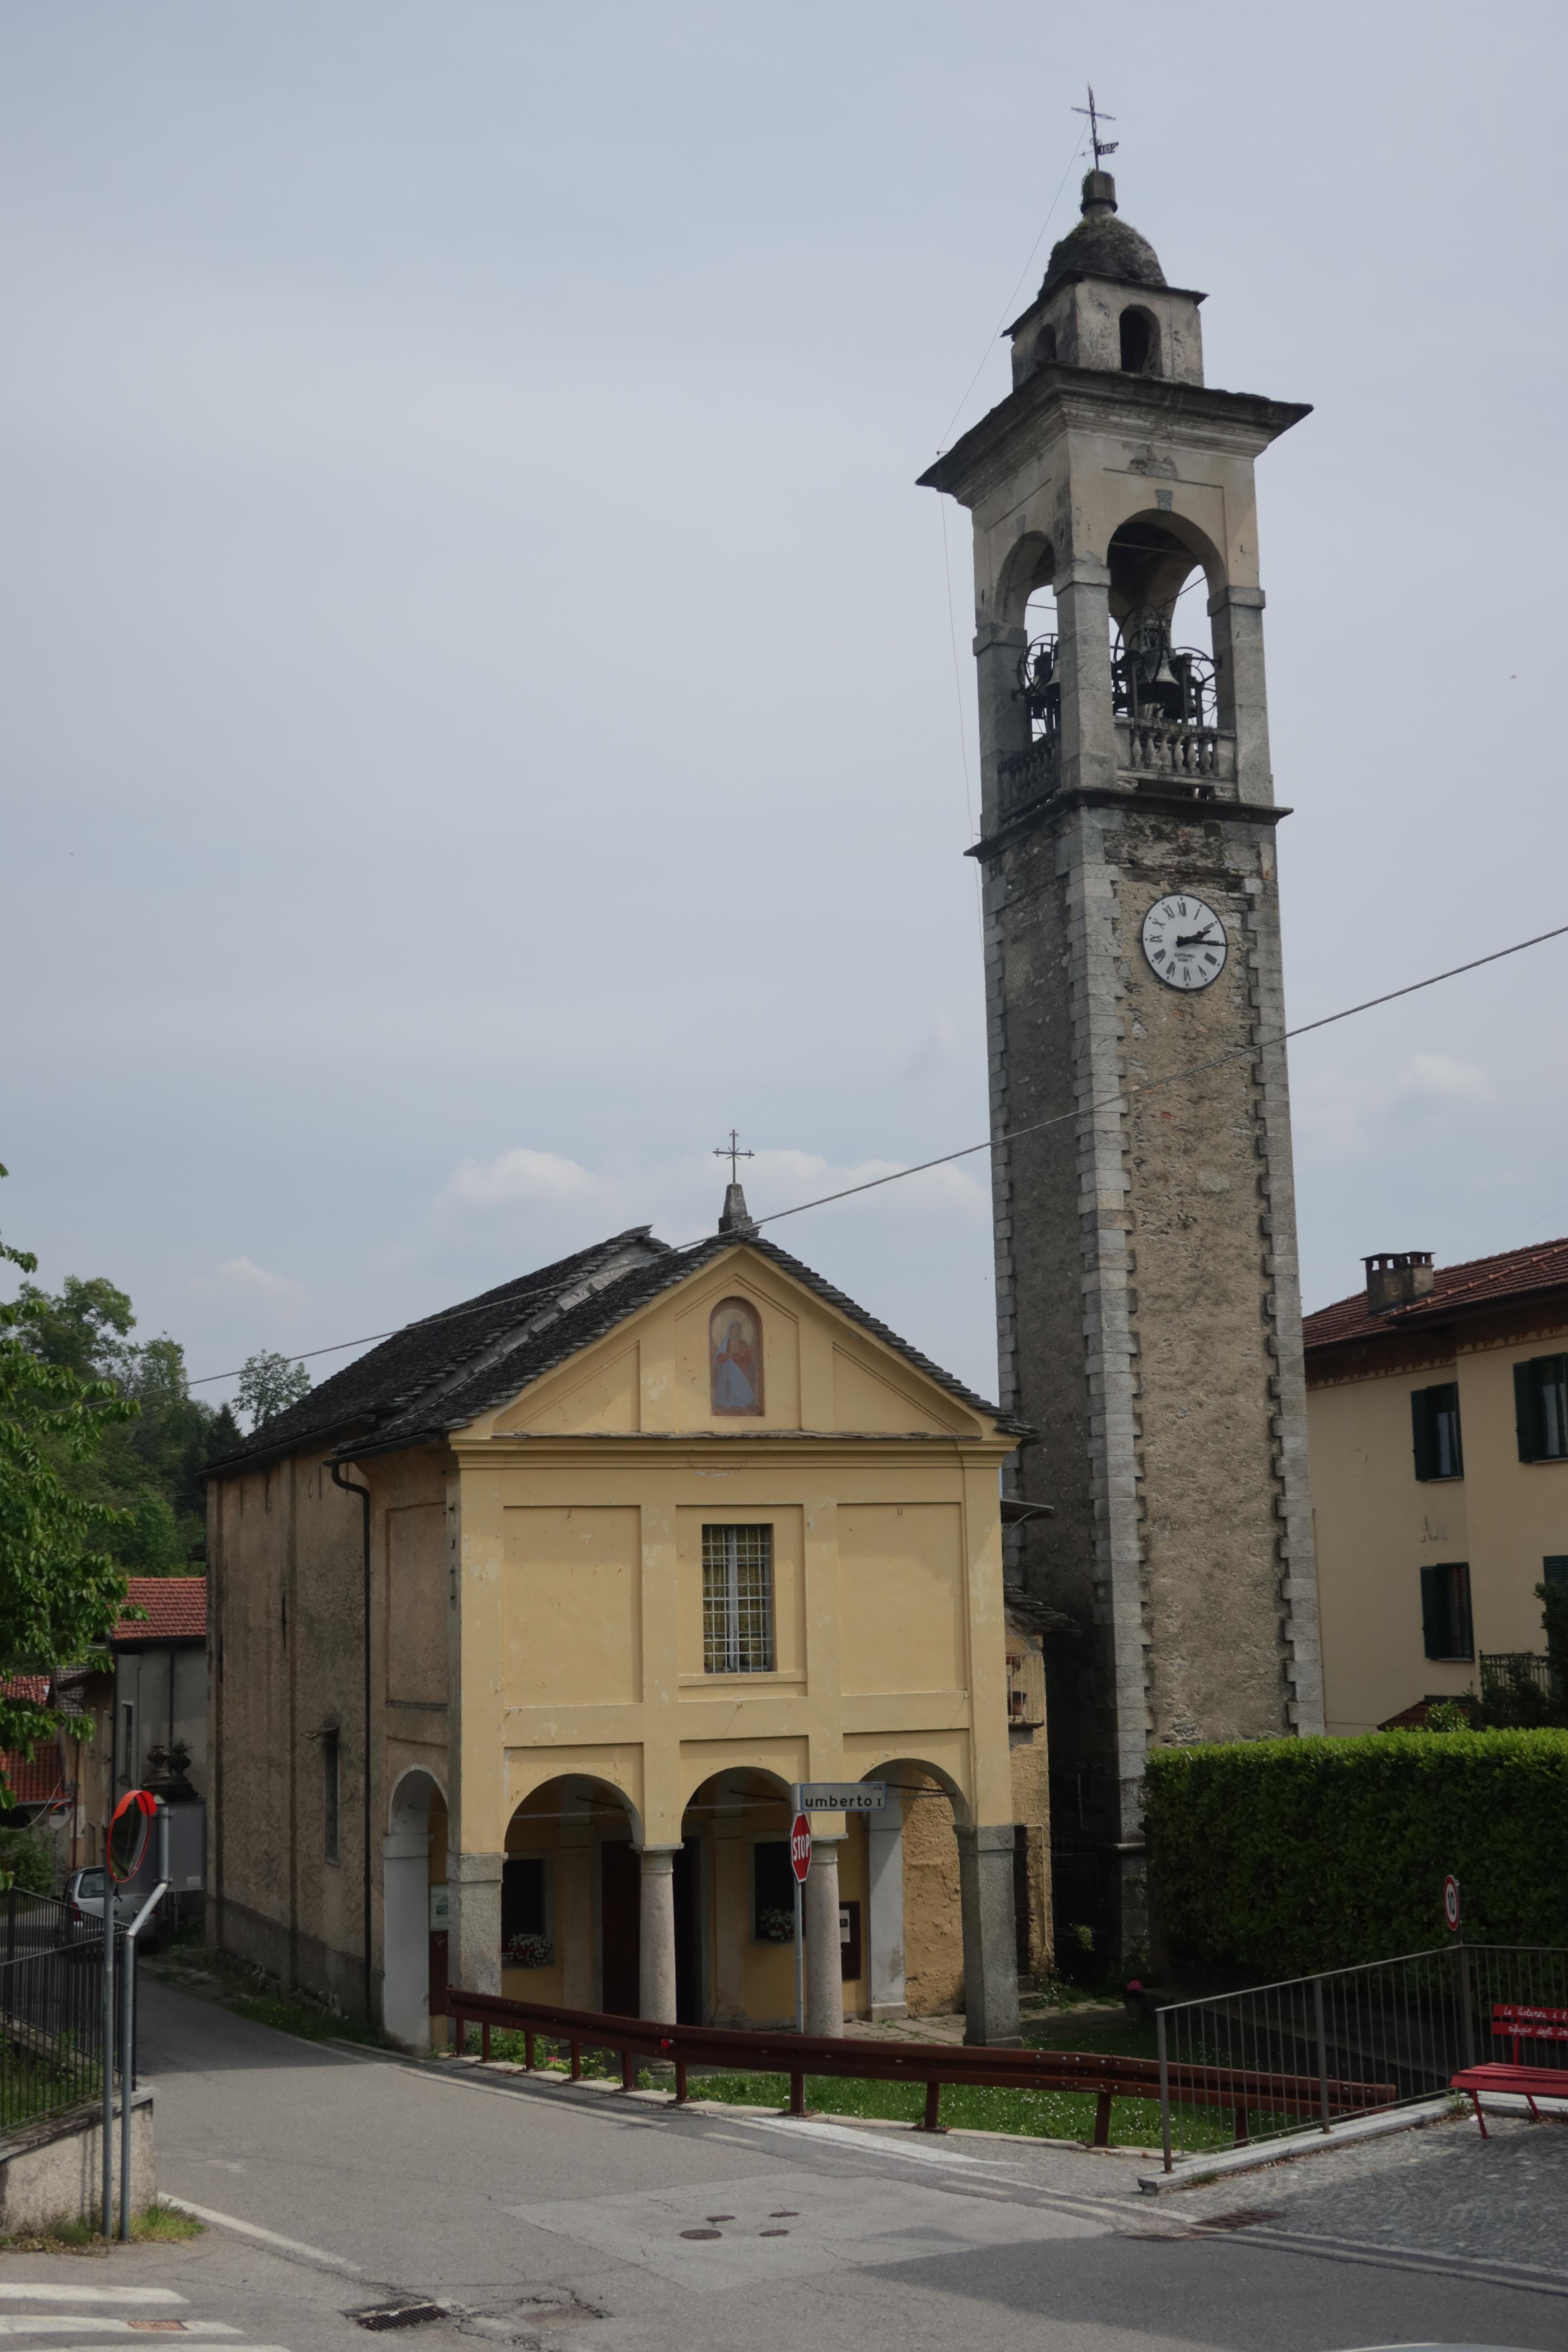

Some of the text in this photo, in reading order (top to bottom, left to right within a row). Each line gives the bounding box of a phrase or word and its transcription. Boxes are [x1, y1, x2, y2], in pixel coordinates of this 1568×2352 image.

[1163, 905, 1175, 920] XI
[1177, 902, 1186, 916] XII
[1152, 918, 1165, 929] X
[1203, 922, 1214, 931] II
[1149, 934, 1162, 942] IX
[1166, 961, 1176, 977] VII
[1184, 966, 1191, 981] VI
[1197, 964, 1207, 977] V
[805, 1795, 872, 1807] umberto
[793, 1833, 810, 1862] STOP
[1448, 1891, 1455, 1915] 10
[1504, 2006, 1512, 2015] La
[1517, 2006, 1547, 2018] Violenza
[1508, 2024, 1568, 2038] rifugio degli in
